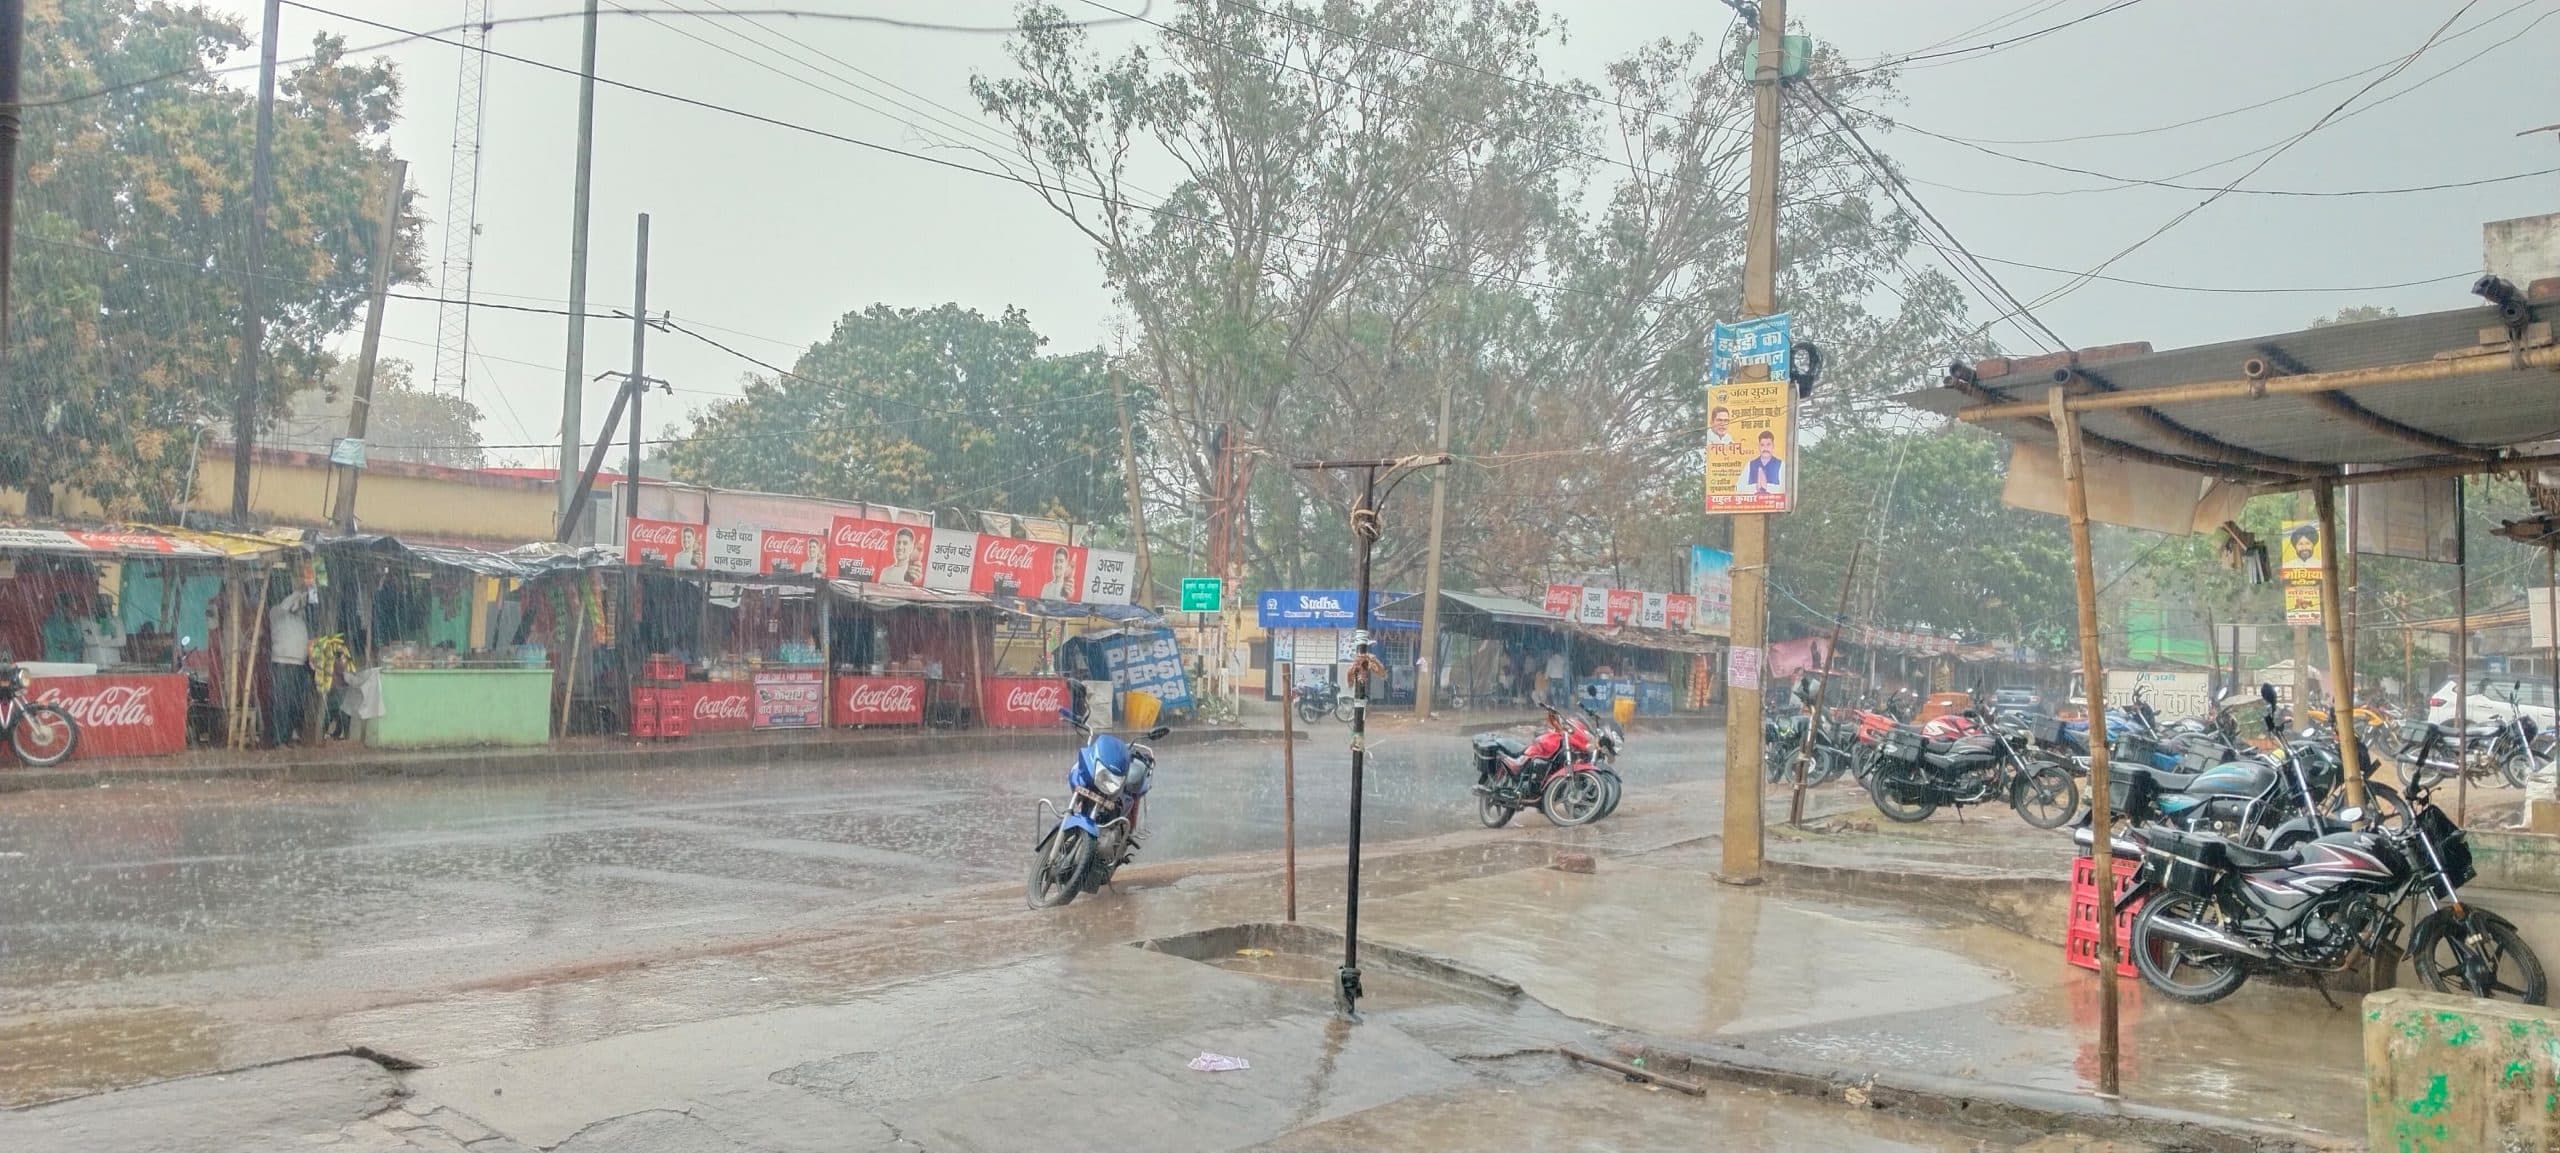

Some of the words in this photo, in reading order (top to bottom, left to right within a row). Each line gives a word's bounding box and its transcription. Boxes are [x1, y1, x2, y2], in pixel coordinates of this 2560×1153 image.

[1730, 388, 1749, 397] जन
[1751, 387, 1778, 399] सुराज
[632, 523, 679, 545] Coca-Cola
[715, 527, 737, 543] केसरी
[738, 529, 753, 543] चाय
[835, 524, 892, 551] Coca-Cola
[764, 536, 805, 554] Coca-Cola
[934, 542, 957, 559] अर्जुन
[984, 540, 1038, 569] Coca-Cola
[714, 555, 728, 567] पान
[730, 557, 752, 570] दुकान
[931, 562, 946, 573] पान
[947, 564, 970, 577] दुकान
[1091, 576, 1101, 594] टी
[1102, 579, 1125, 597] स्टॉल
[1300, 595, 1341, 610] Sudha
[1111, 658, 1182, 688] PEPSI
[694, 696, 747, 719] Coca-Cola
[850, 684, 916, 712] Coca-Cola
[1008, 687, 1061, 712] Coca-Cola
